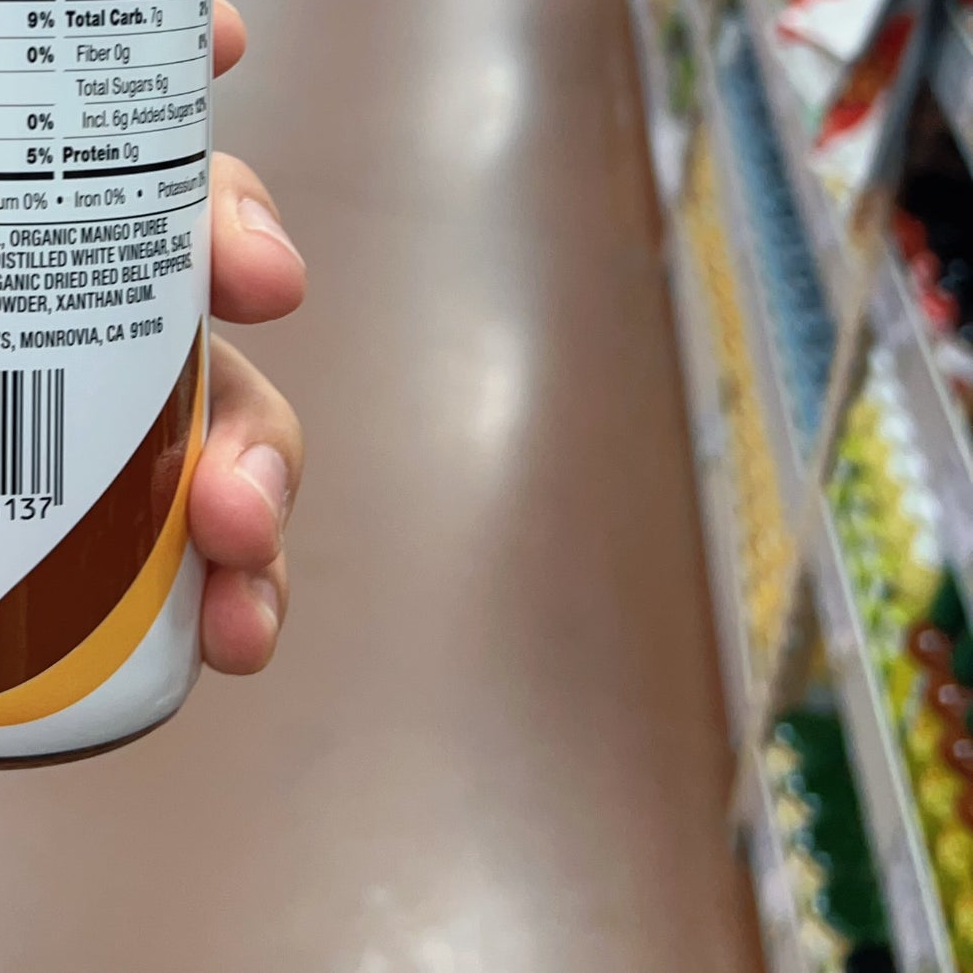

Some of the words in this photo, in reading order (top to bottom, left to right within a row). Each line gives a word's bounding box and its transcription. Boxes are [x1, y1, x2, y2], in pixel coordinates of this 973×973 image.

[28, 10, 55, 28] 9%
[65, 9, 105, 27] Total
[109, 7, 147, 26] Carb.
[150, 6, 163, 27] 7g
[27, 45, 54, 63] 0%
[77, 44, 111, 62] Fiber
[114, 43, 130, 64] 0g
[76, 78, 109, 97] Total
[112, 76, 153, 98] Sugars
[156, 74, 169, 94] 6g
[27, 113, 54, 130] 0%
[82, 110, 109, 129] Incl.
[112, 109, 128, 130] 6g
[130, 102, 165, 126] Added
[167, 100, 194, 122] Sugars
[27, 147, 53, 164] 5%
[63, 144, 119, 163] Protein
[123, 142, 139, 162] 0g
[23, 192, 48, 210] 0%
[75, 190, 101, 208] Iron
[104, 188, 126, 207] 0%
[10, 228, 77, 247] ORGANIC
[80, 223, 130, 244] MANGO
[133, 217, 168, 238] PUREE
[71, 246, 115, 266] WHITE
[118, 238, 170, 262] VINEGAR,
[44, 270, 87, 290] DRIED
[91, 268, 118, 287] RED
[121, 263, 151, 283] BELL
[56, 289, 123, 311] XANTHAN
[126, 284, 156, 305] GUM.
[20, 327, 103, 347] MONROVIA,
[107, 324, 125, 343] CA
[130, 316, 164, 339] 91016
